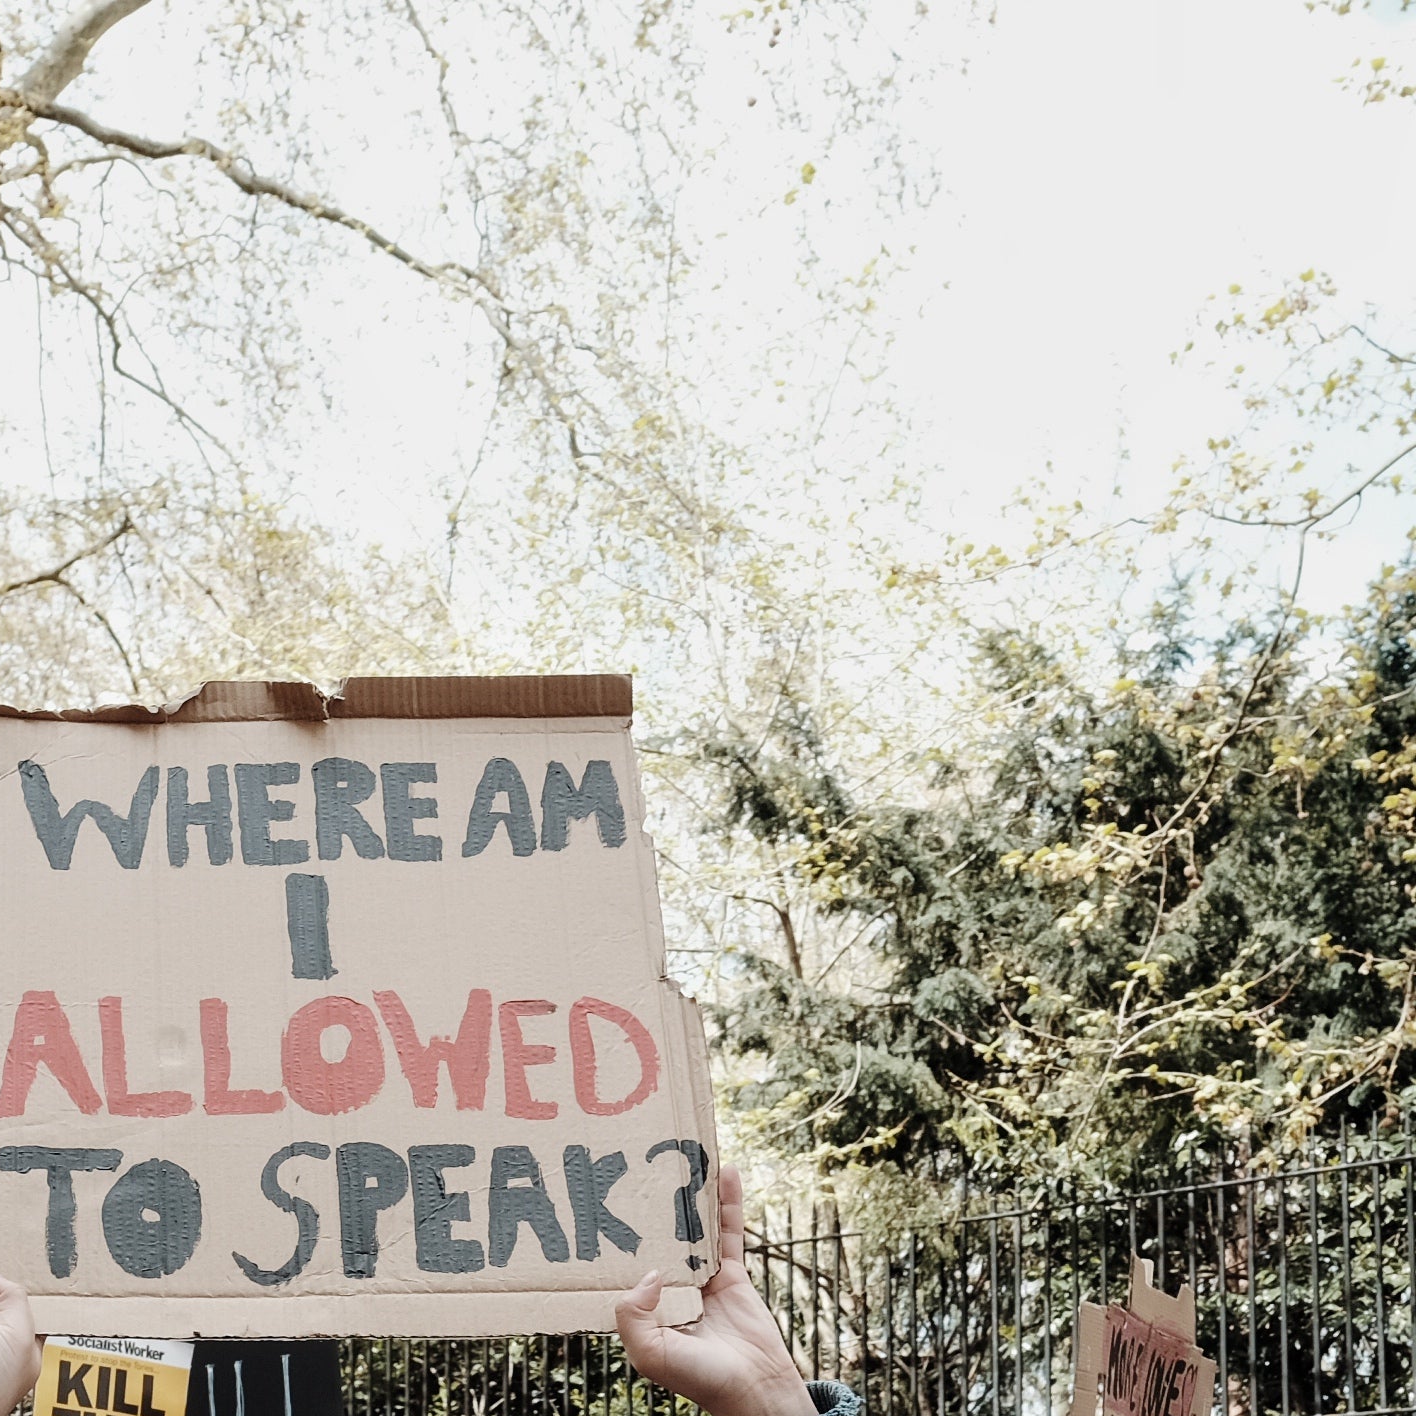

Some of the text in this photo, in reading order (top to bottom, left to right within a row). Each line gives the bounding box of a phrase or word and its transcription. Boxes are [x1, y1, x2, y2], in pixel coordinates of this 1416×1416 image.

[17, 756, 628, 871] WHERE AM
[285, 873, 339, 980] I
[232, 1139, 710, 1287] SPEAK?
[124, 1341, 165, 1361] Worker
[1107, 1324, 1144, 1412] MORE
